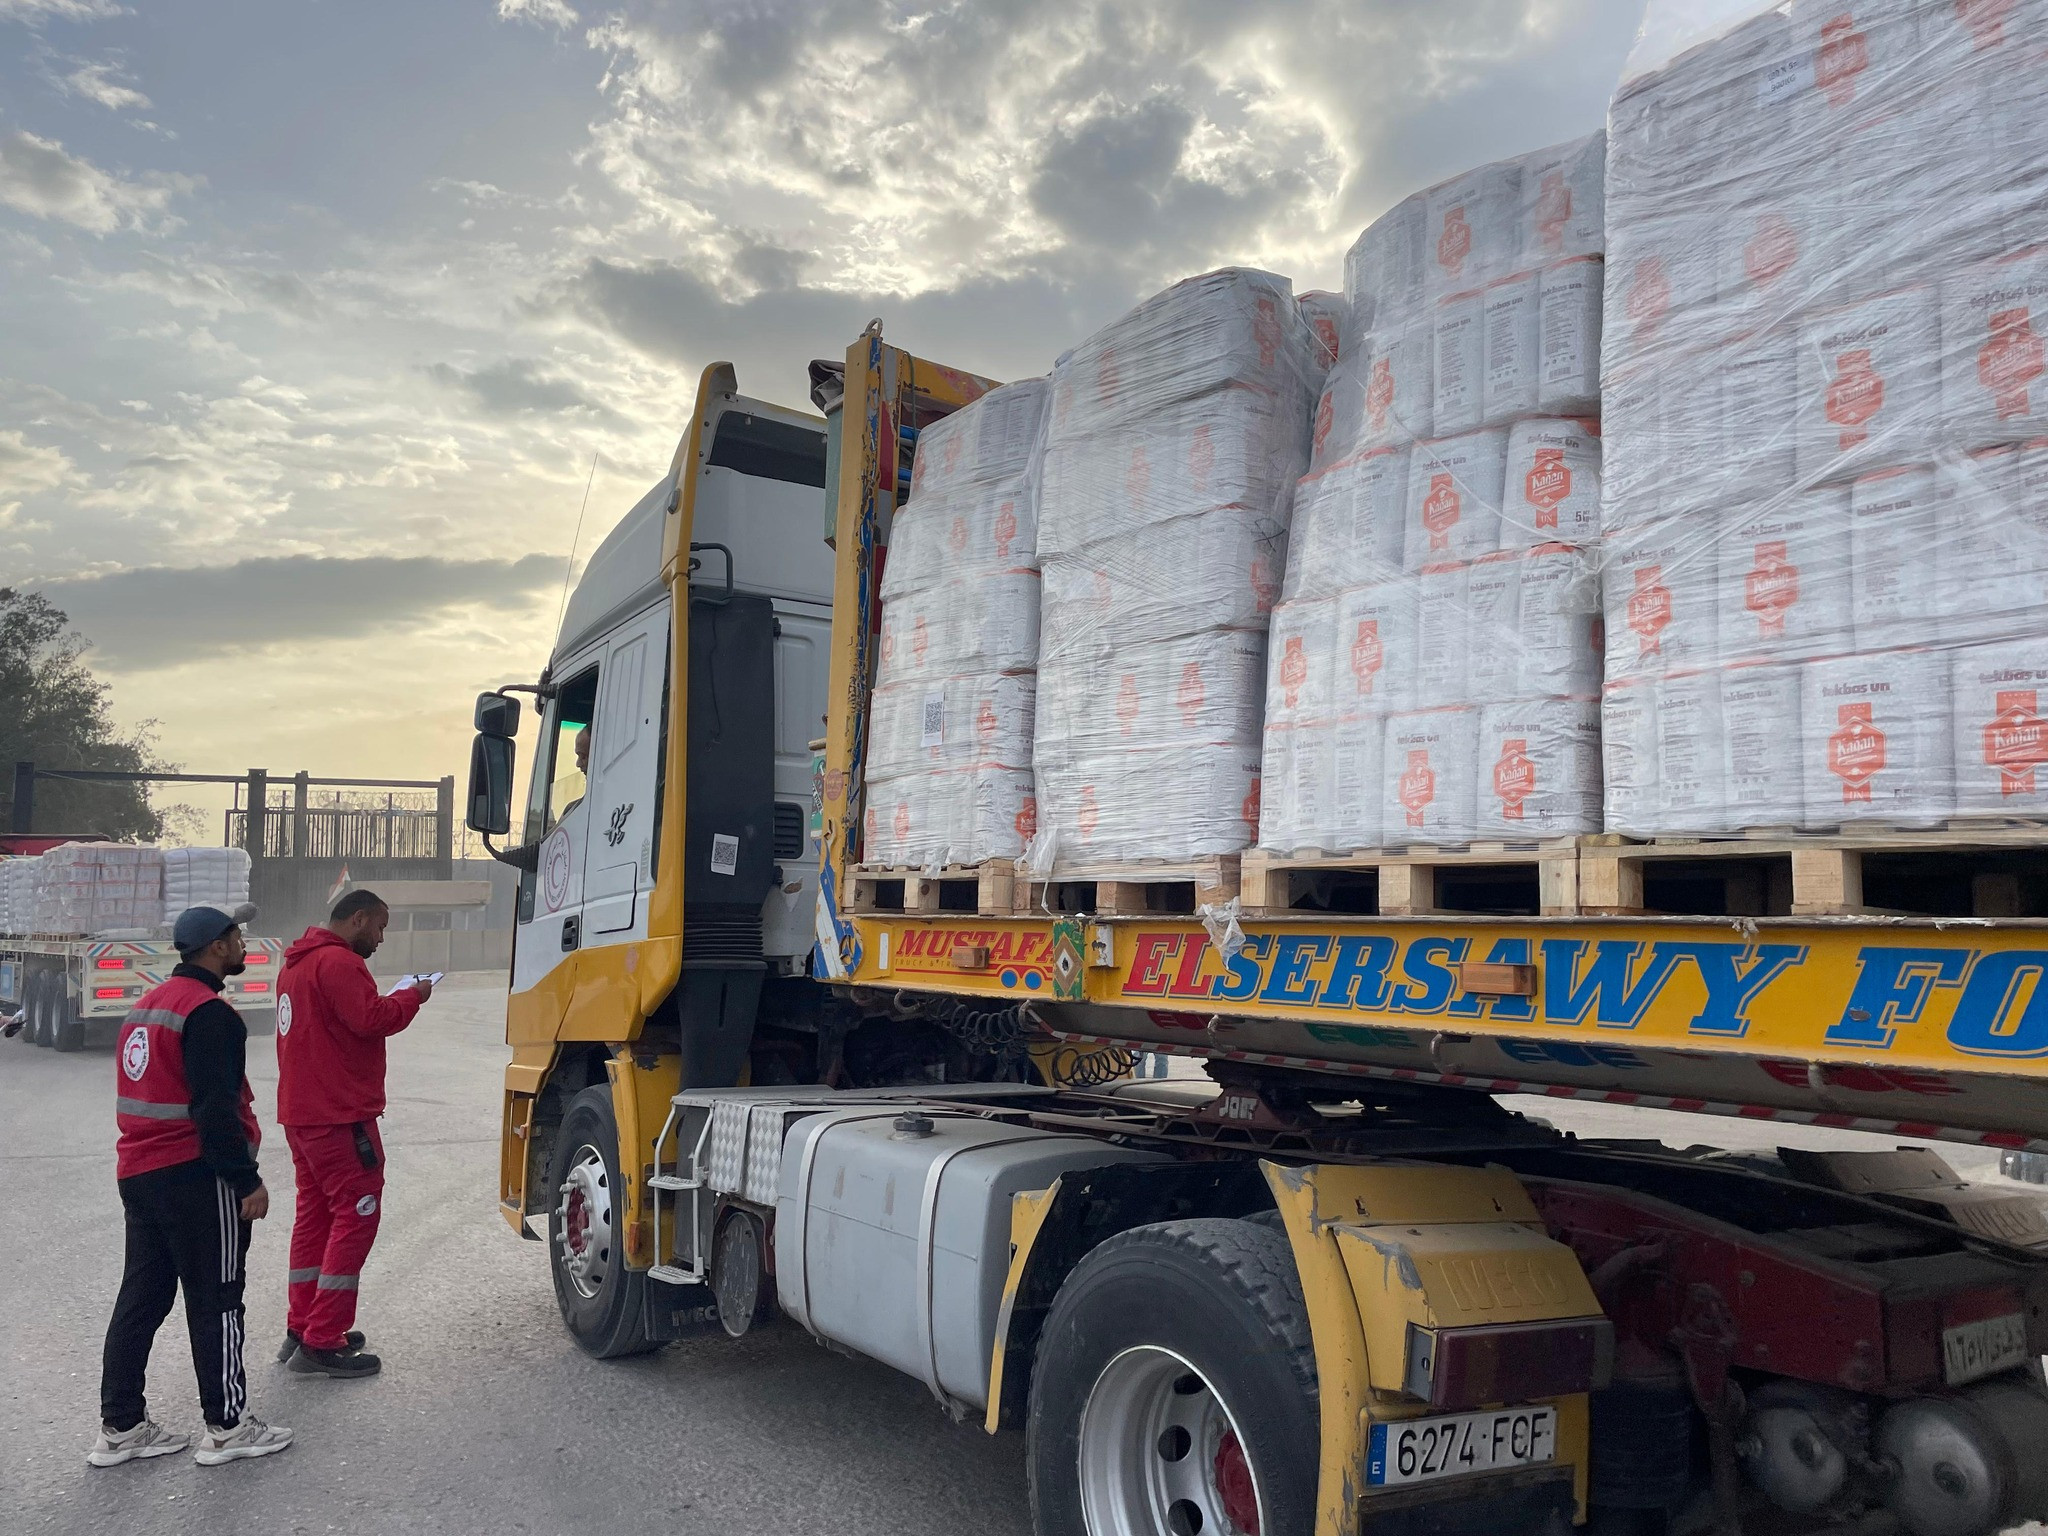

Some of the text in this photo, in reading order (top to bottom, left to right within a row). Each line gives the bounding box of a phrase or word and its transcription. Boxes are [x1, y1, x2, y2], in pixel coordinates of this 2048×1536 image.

[1870, 682, 1890, 692] un
[1121, 933, 1809, 1038] ELSERSAWY
[1397, 1412, 1549, 1477] 6274 FCF
[1371, 1461, 1381, 1475] E
